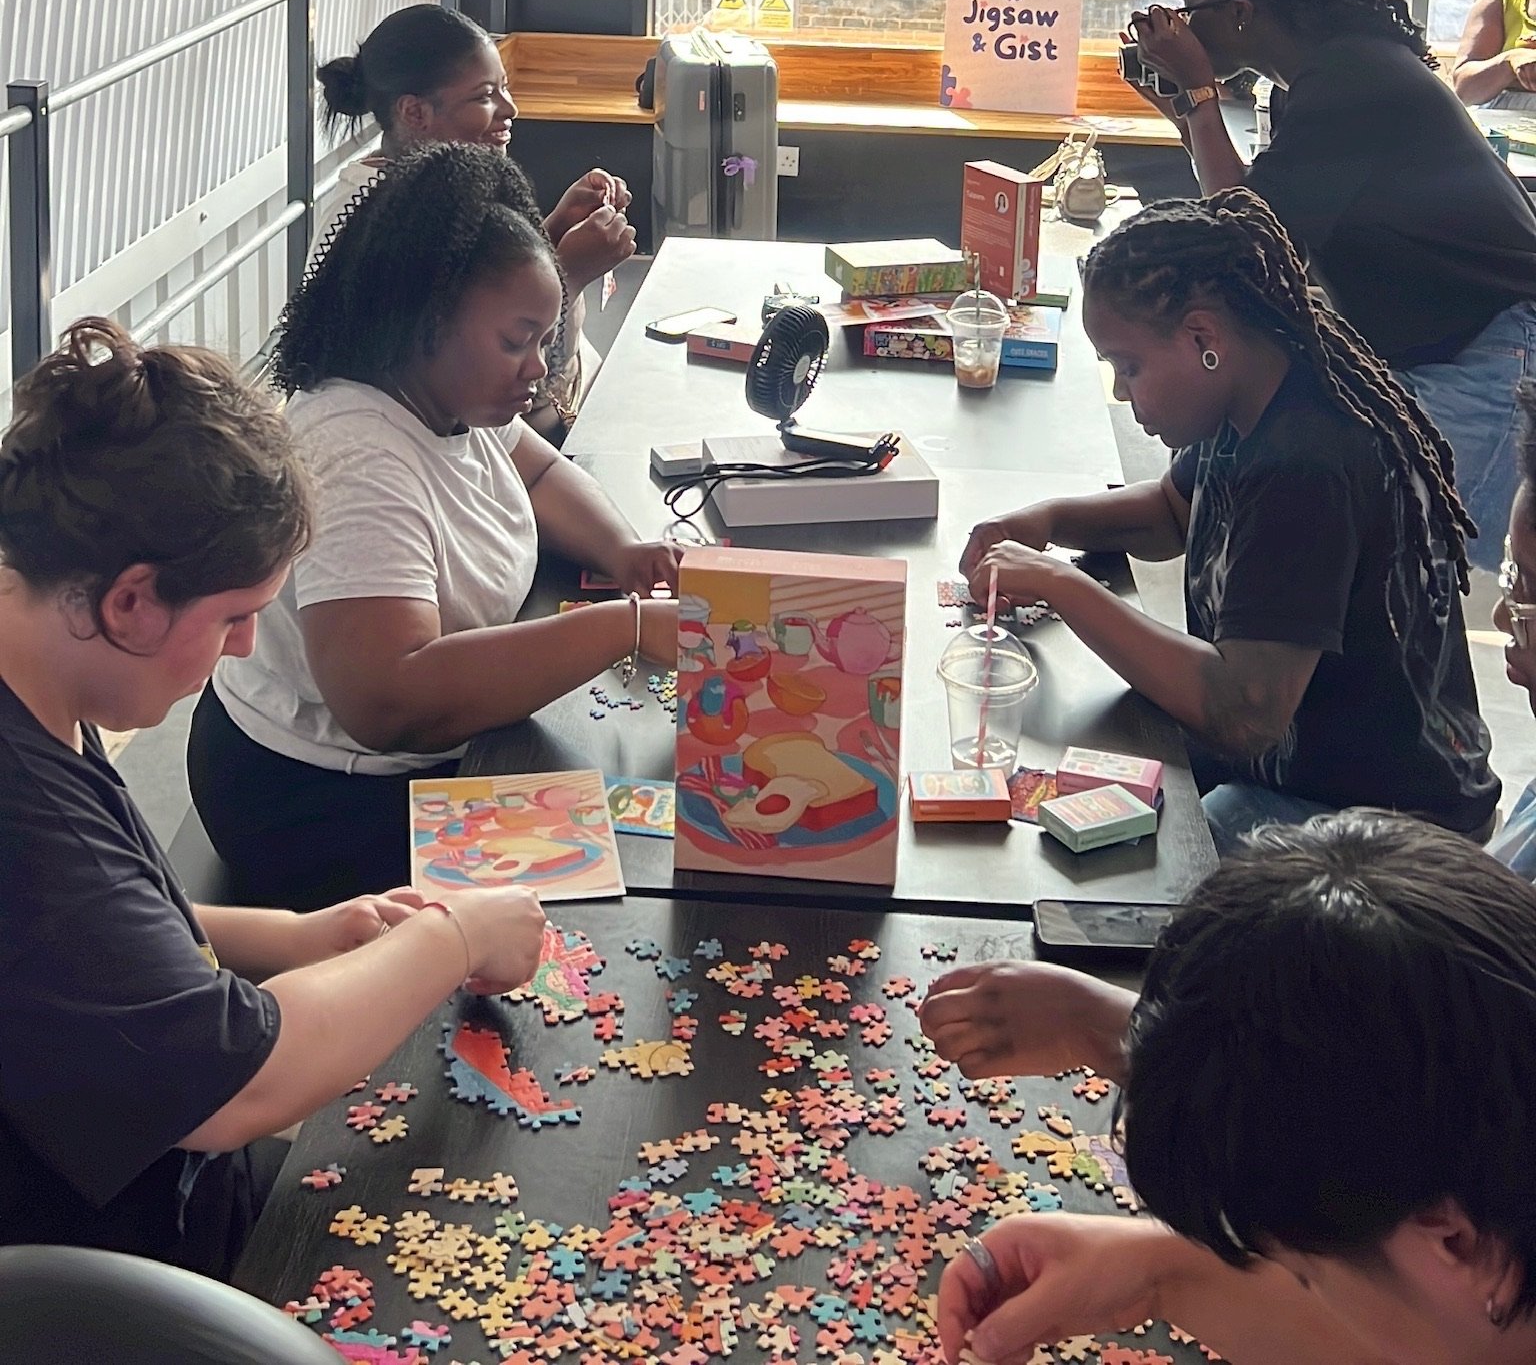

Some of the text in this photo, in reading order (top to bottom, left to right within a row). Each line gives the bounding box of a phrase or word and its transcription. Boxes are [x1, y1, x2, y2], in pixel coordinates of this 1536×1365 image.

[963, 0, 1059, 31] Jigsaw
[972, 32, 1057, 60] & Gist
